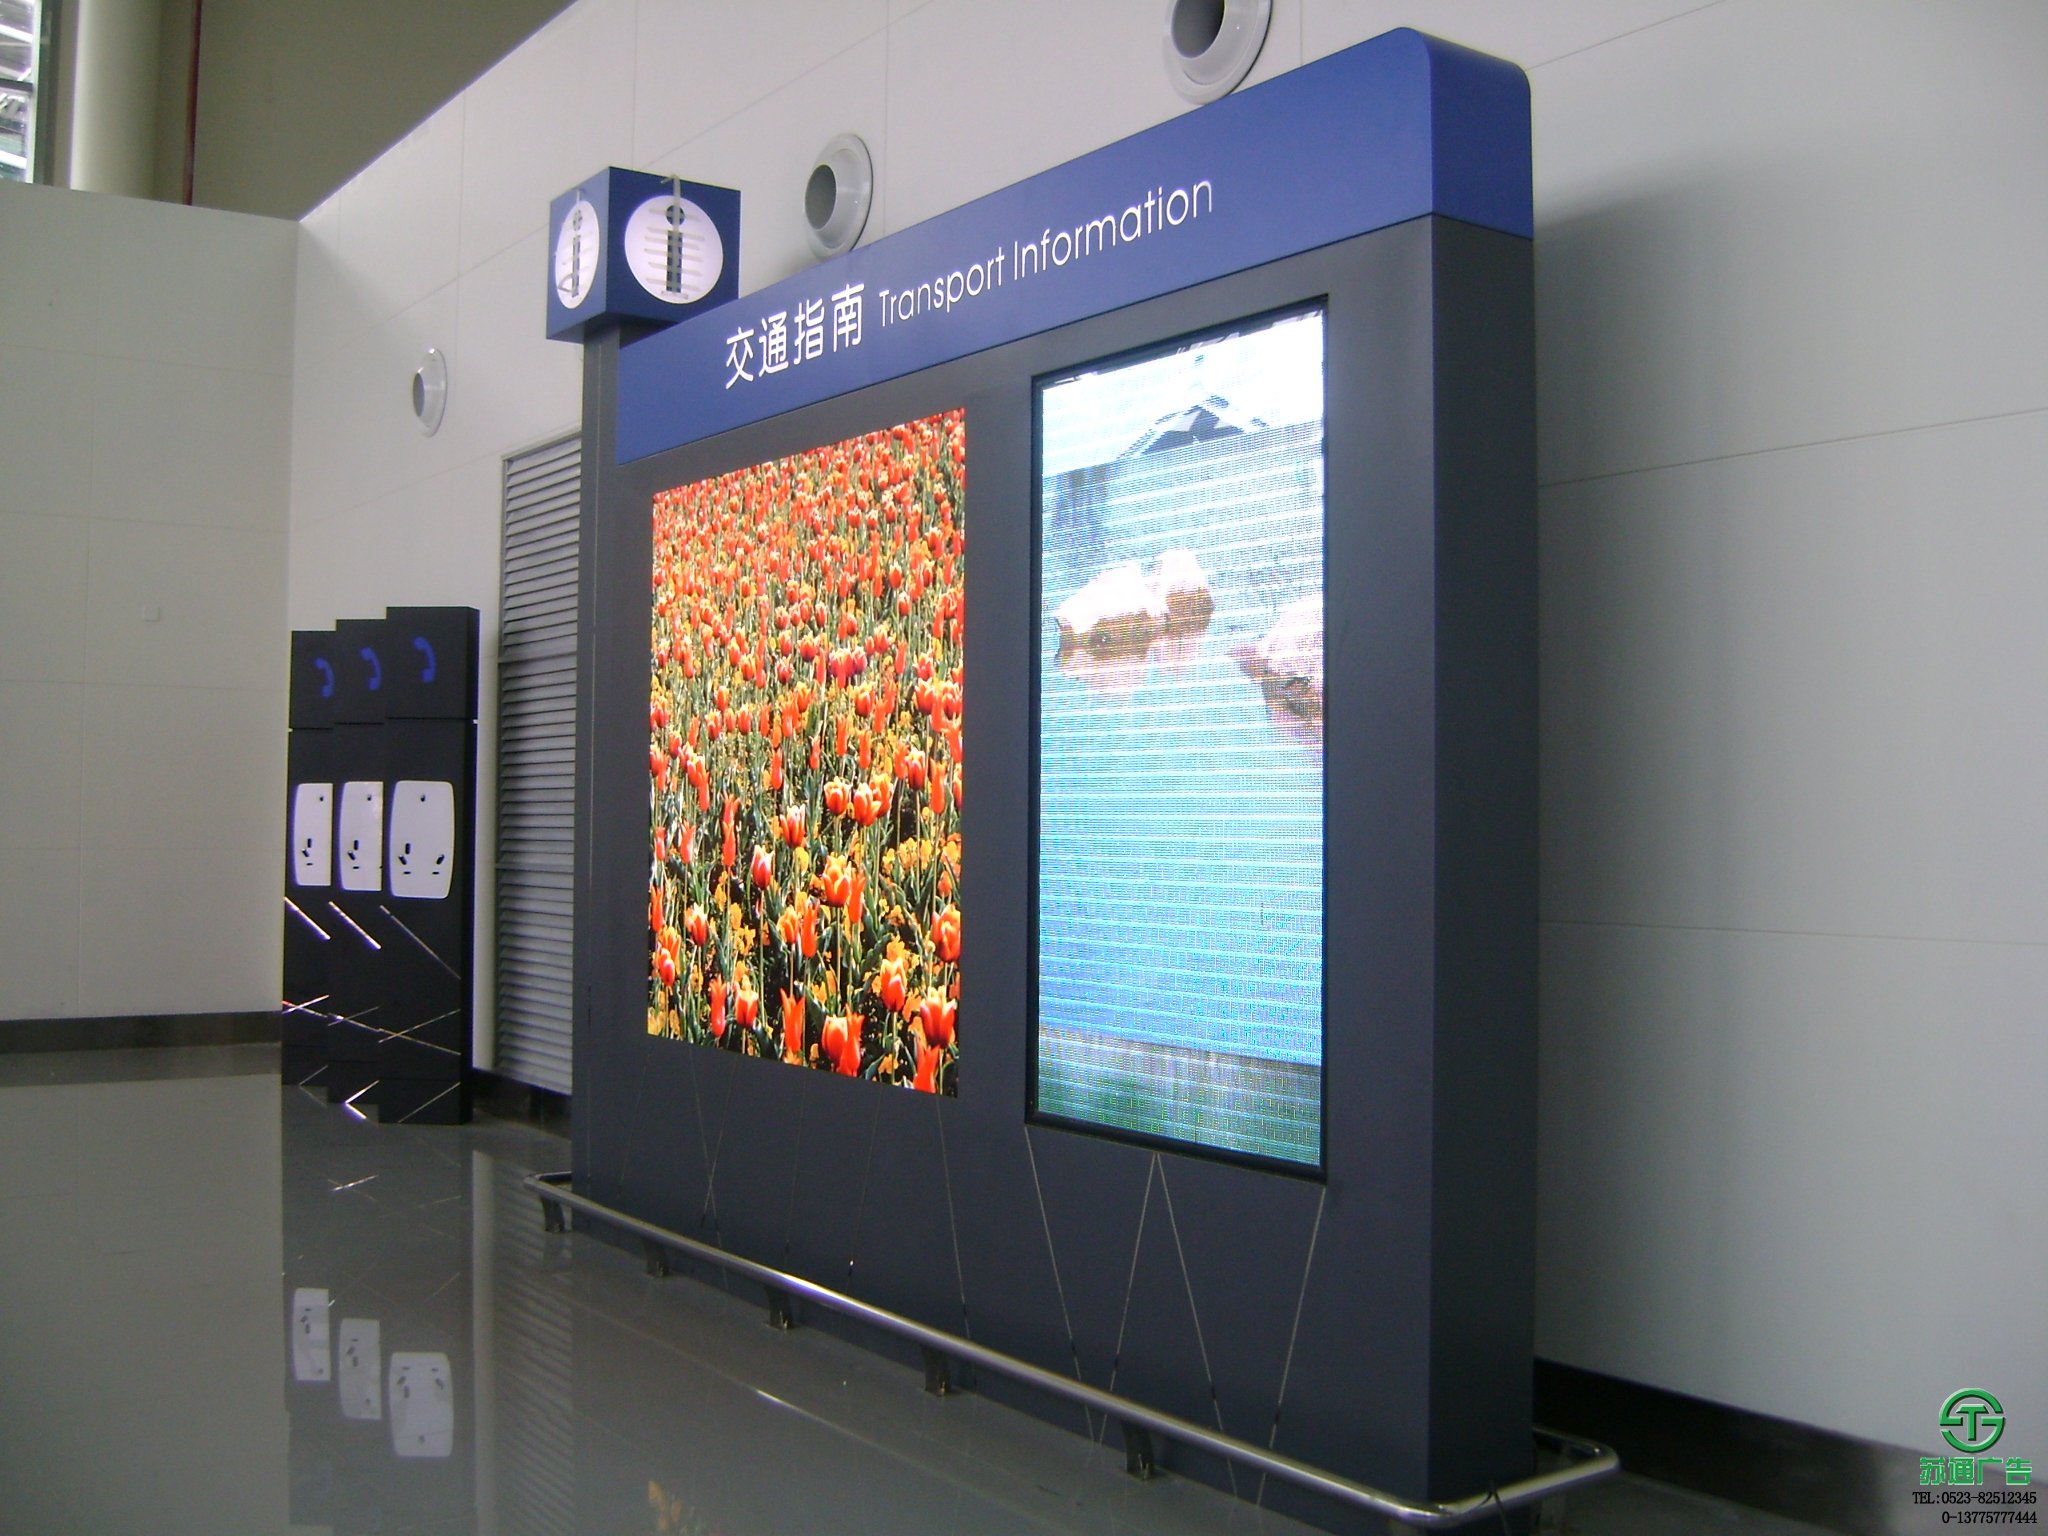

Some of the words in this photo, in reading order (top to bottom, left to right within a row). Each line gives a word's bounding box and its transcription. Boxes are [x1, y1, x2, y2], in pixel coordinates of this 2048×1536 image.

[726, 282, 865, 390] 交通指南
[879, 246, 1005, 328] Transport
[1014, 179, 1213, 281] Information
